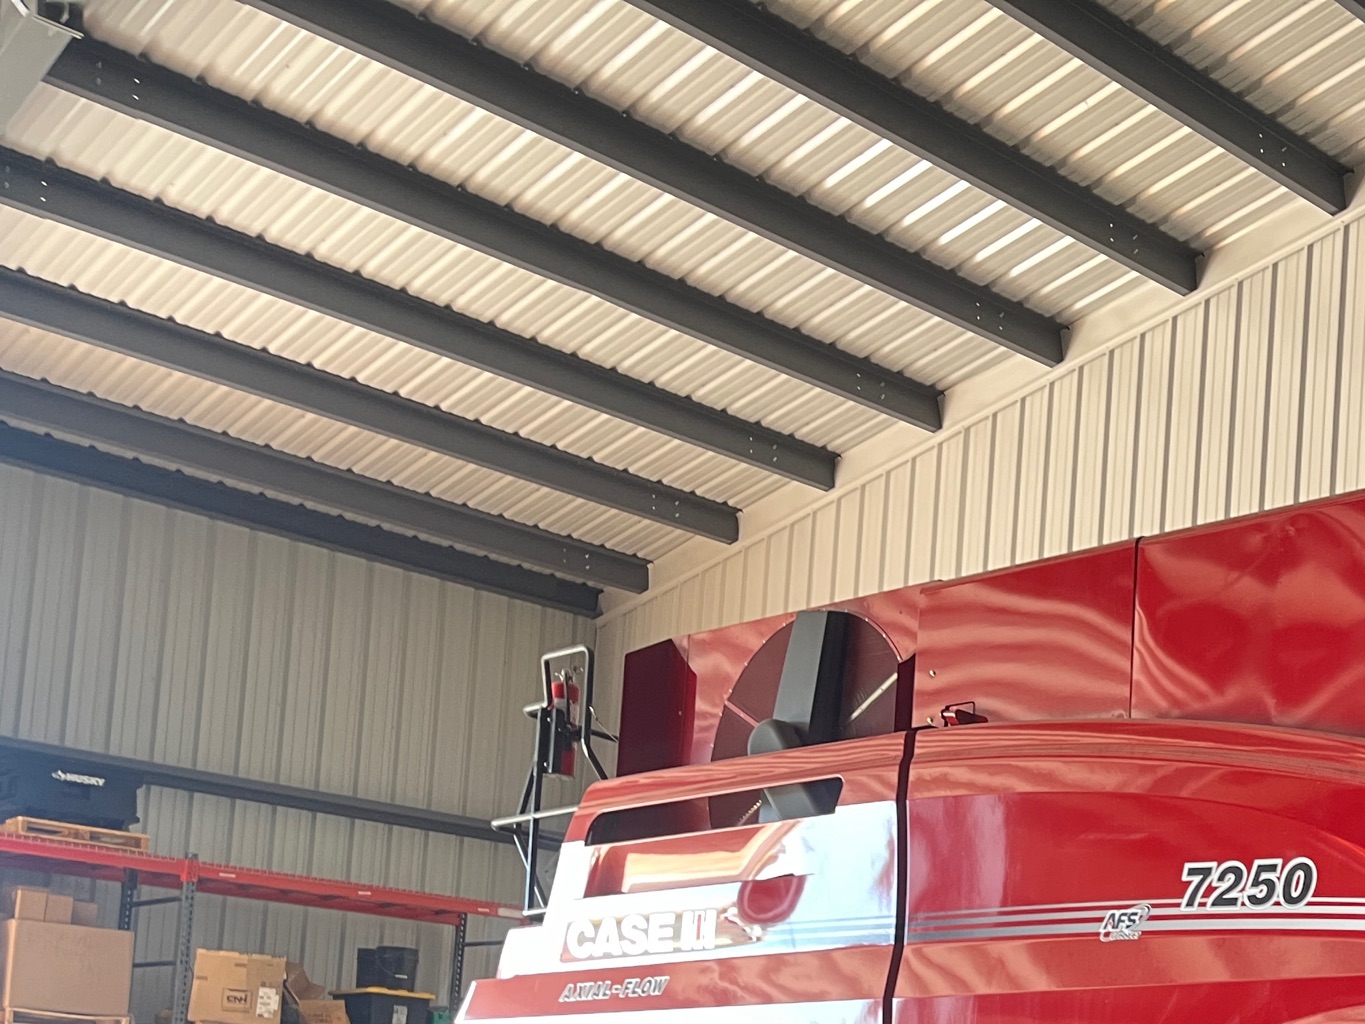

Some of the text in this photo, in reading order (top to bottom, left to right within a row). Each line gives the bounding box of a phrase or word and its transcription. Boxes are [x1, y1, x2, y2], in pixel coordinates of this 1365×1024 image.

[1180, 857, 1317, 911] 7250
[566, 911, 675, 960] CASE
[1100, 910, 1141, 932] AFS
[559, 976, 669, 1002] AXIAL-FLOW
